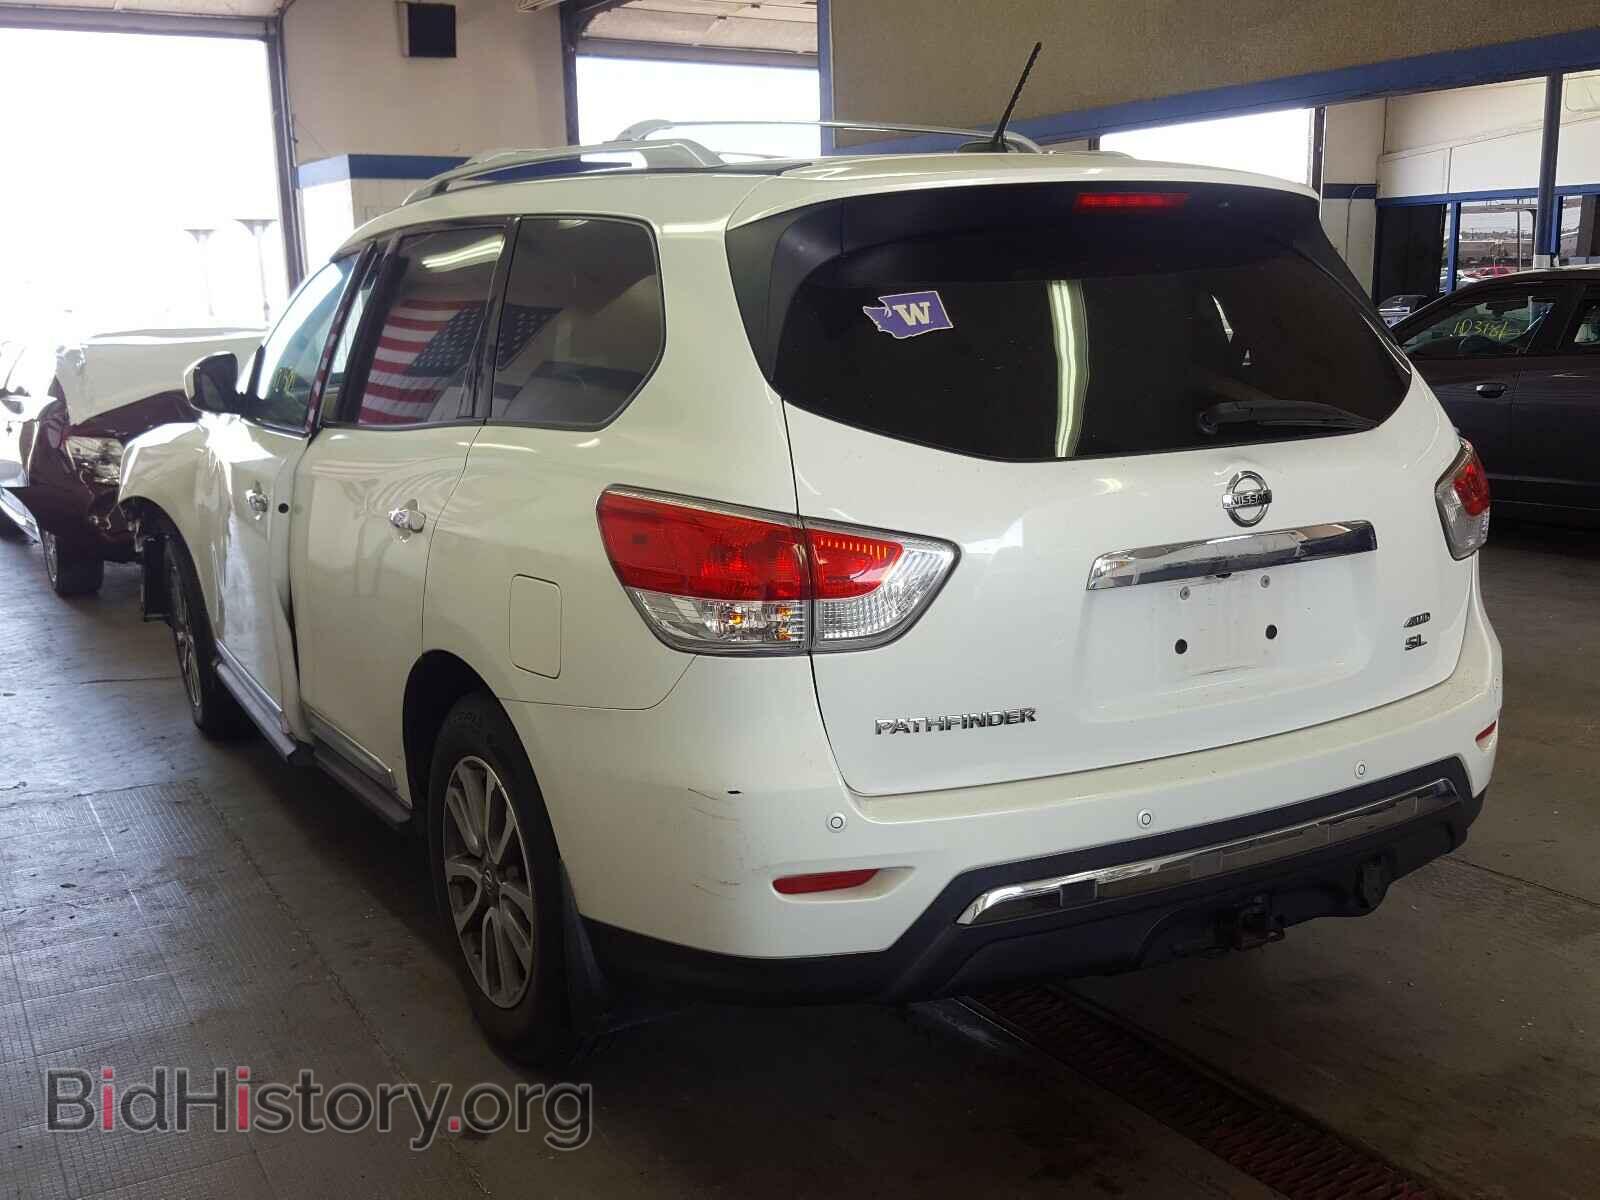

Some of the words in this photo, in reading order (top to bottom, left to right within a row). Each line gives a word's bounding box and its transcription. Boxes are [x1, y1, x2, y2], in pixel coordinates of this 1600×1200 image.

[1231, 493, 1269, 506] NISSAN
[1404, 634, 1428, 651] SL
[875, 707, 1037, 735] PATHFINDER
